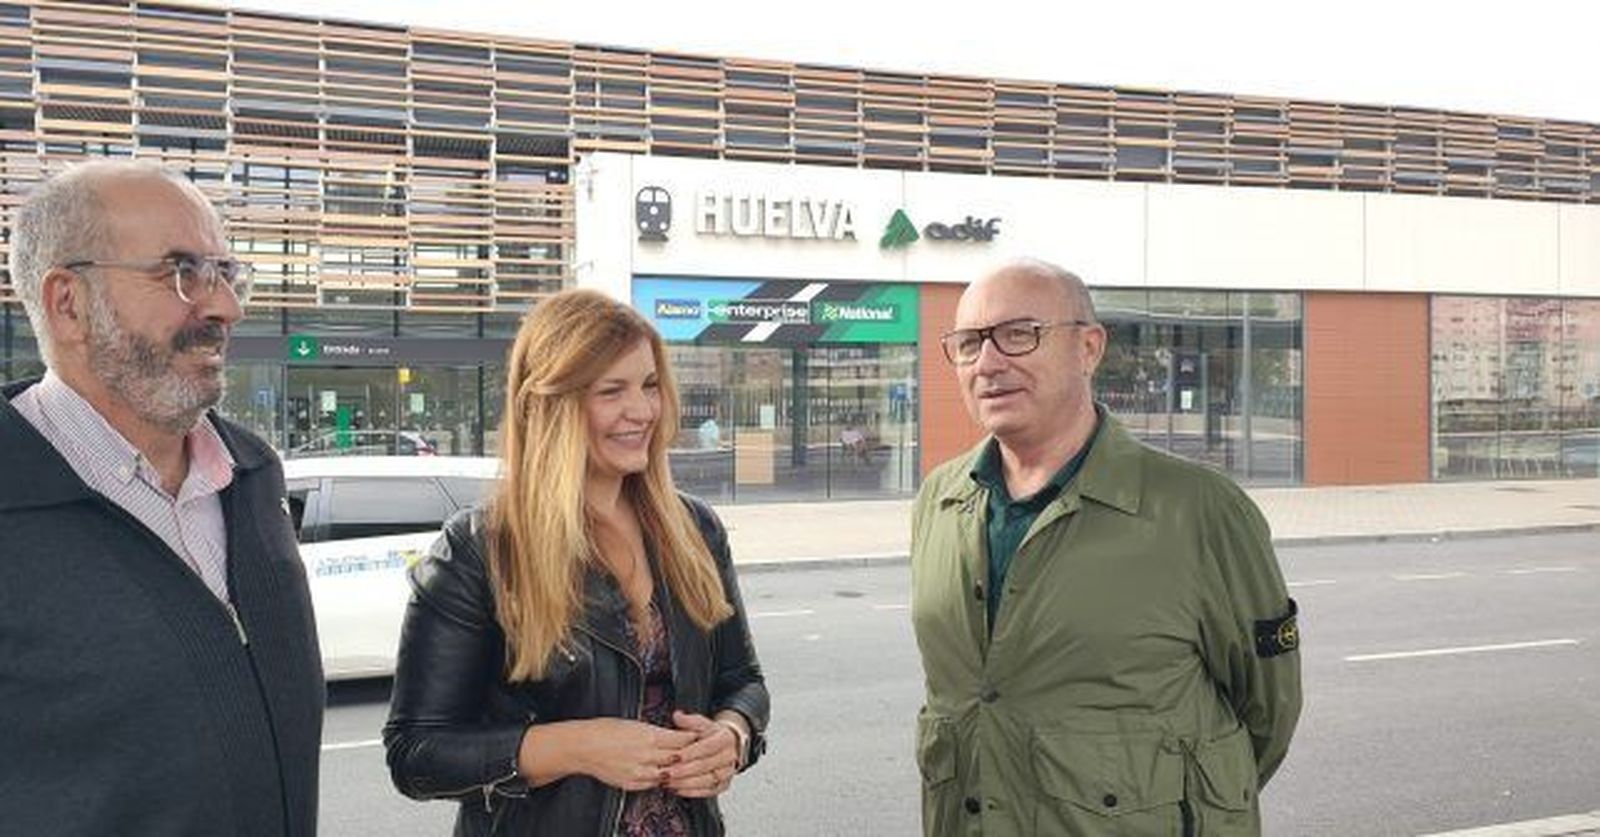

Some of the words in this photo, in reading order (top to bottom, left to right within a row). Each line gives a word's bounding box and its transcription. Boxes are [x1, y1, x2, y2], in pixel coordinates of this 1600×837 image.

[695, 189, 859, 242] HUELVA
[923, 215, 1002, 242] adif
[656, 302, 700, 316] Alamo
[710, 302, 809, 319] enterprise
[839, 304, 894, 320] National
